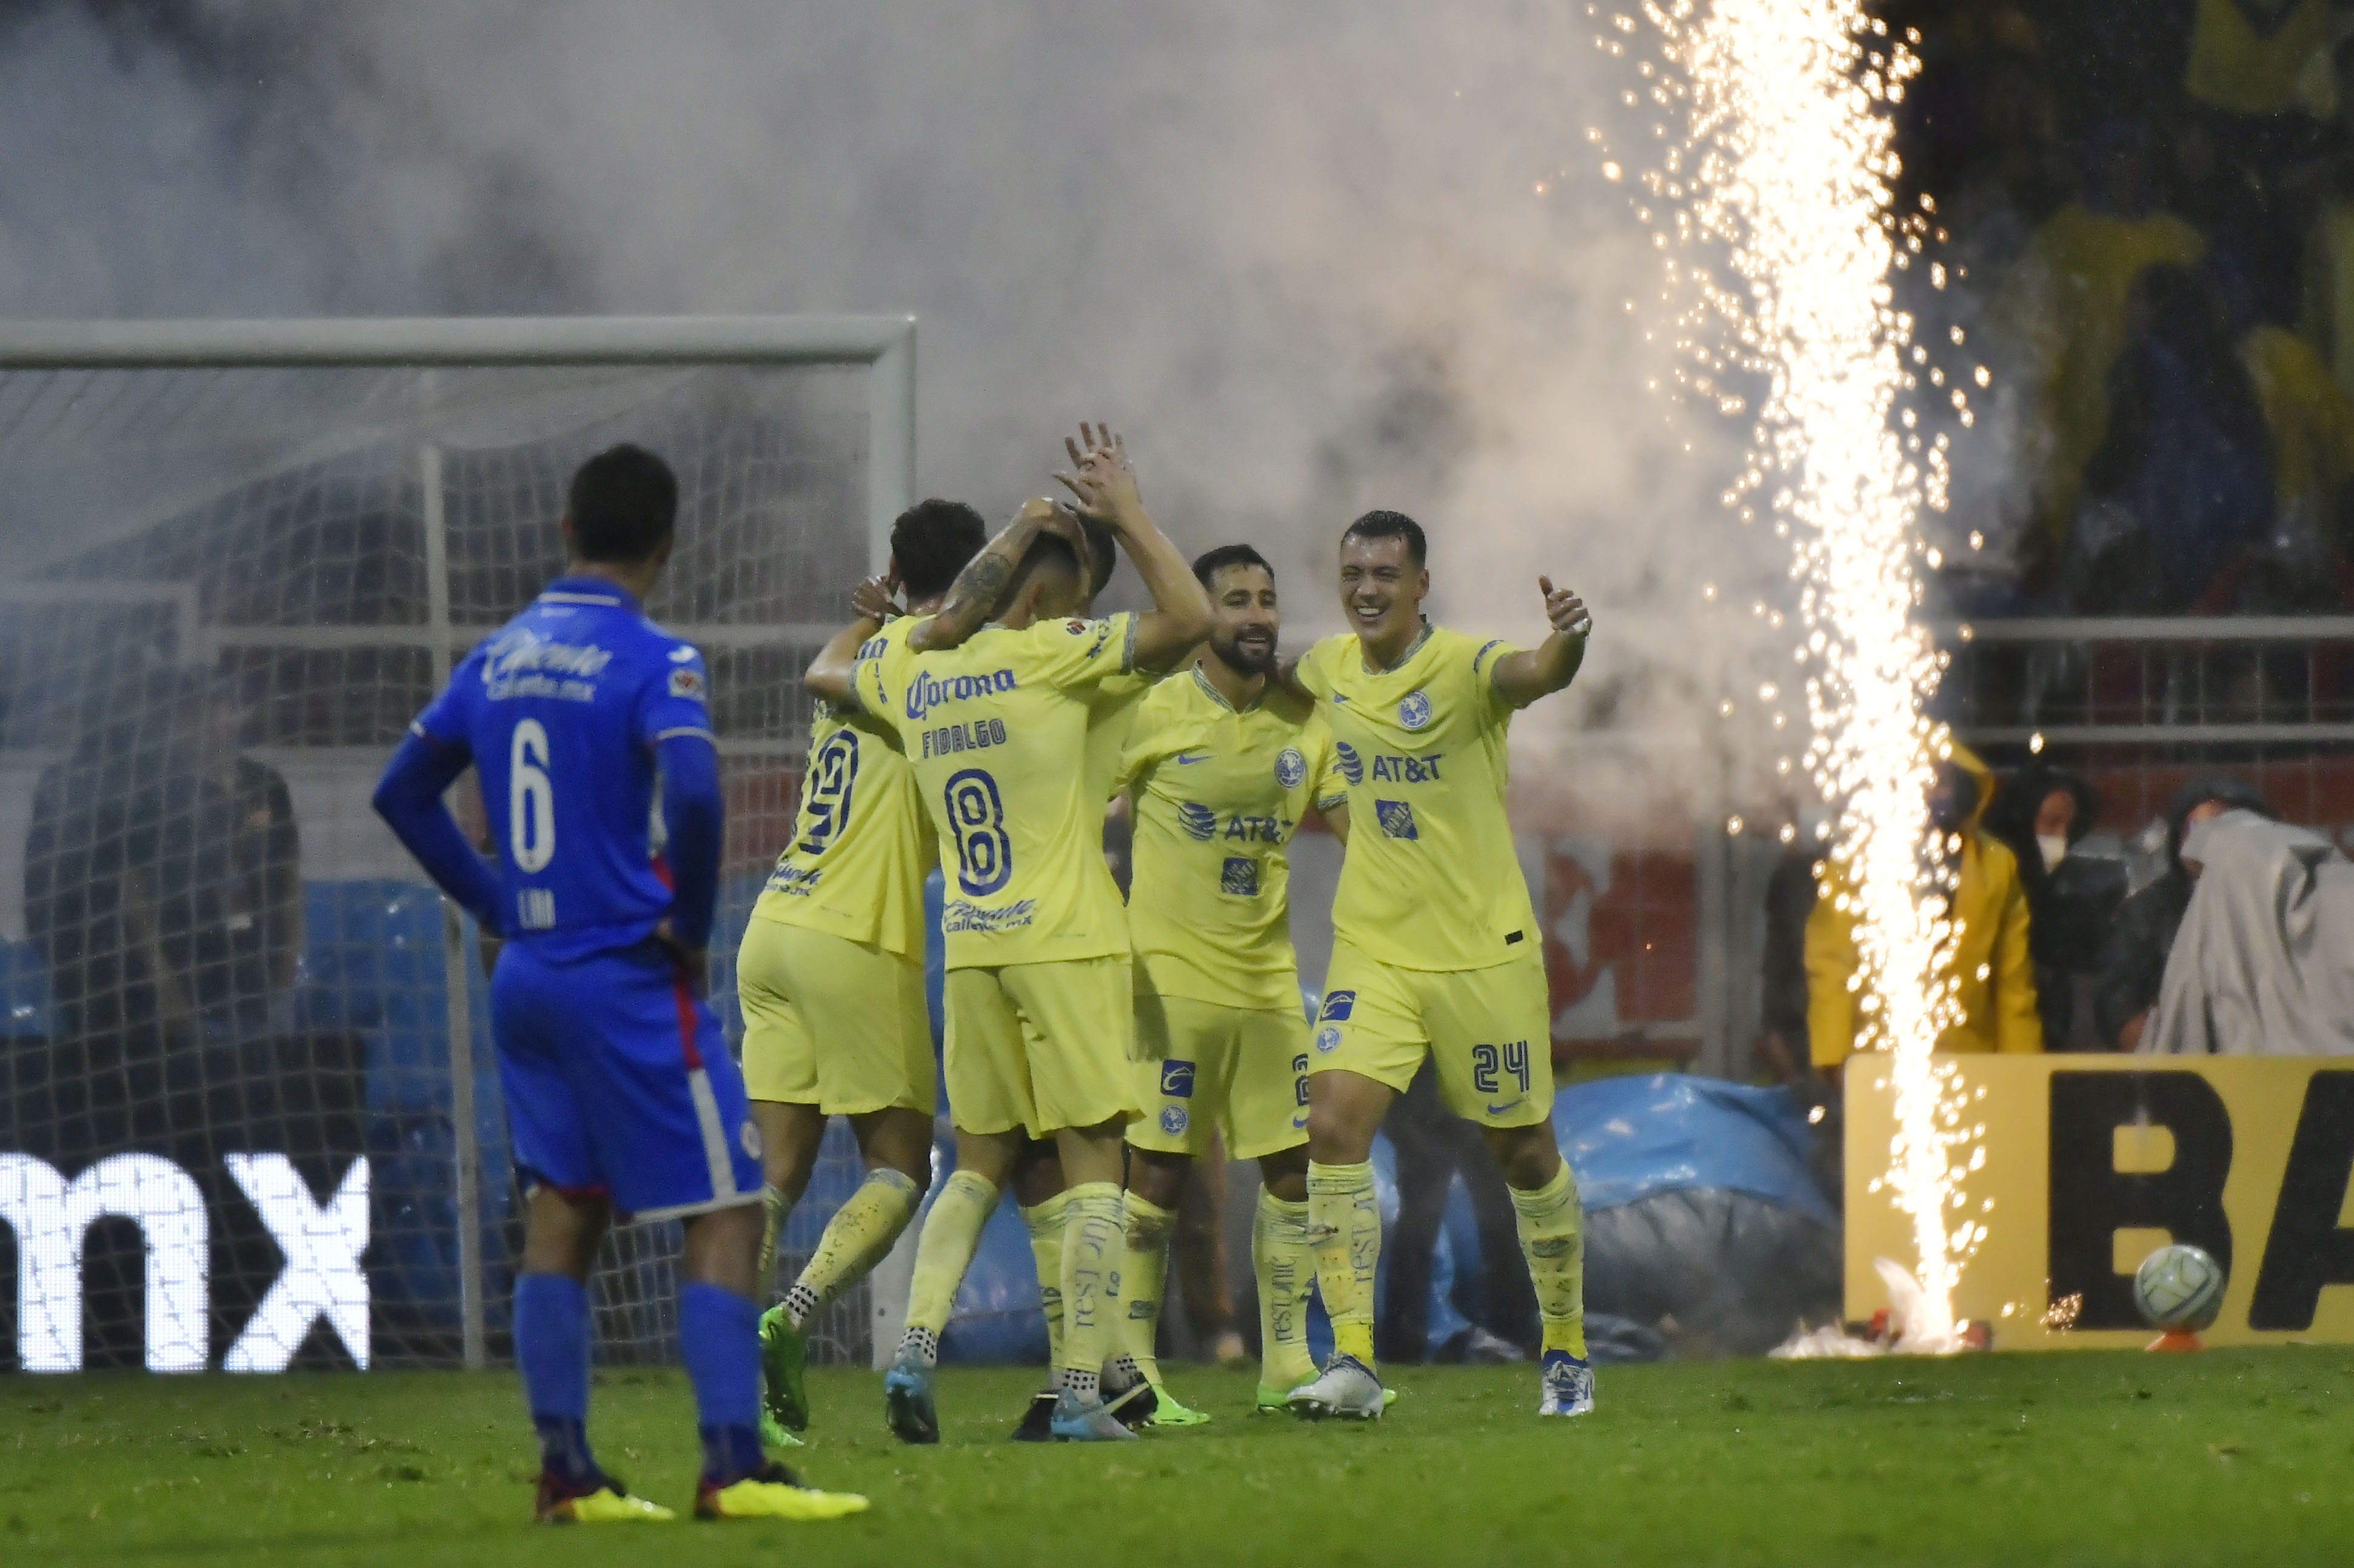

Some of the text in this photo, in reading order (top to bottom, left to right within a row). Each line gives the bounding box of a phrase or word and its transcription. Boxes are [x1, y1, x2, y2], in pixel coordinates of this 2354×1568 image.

[906, 668, 1015, 721] Corona
[922, 718, 1006, 759] FIDALGO
[510, 718, 556, 873] 6
[1372, 753, 1445, 783] AT&T
[944, 768, 1012, 897] 8
[1471, 1039, 1531, 1094] 24
[0, 1152, 371, 1373] mx
